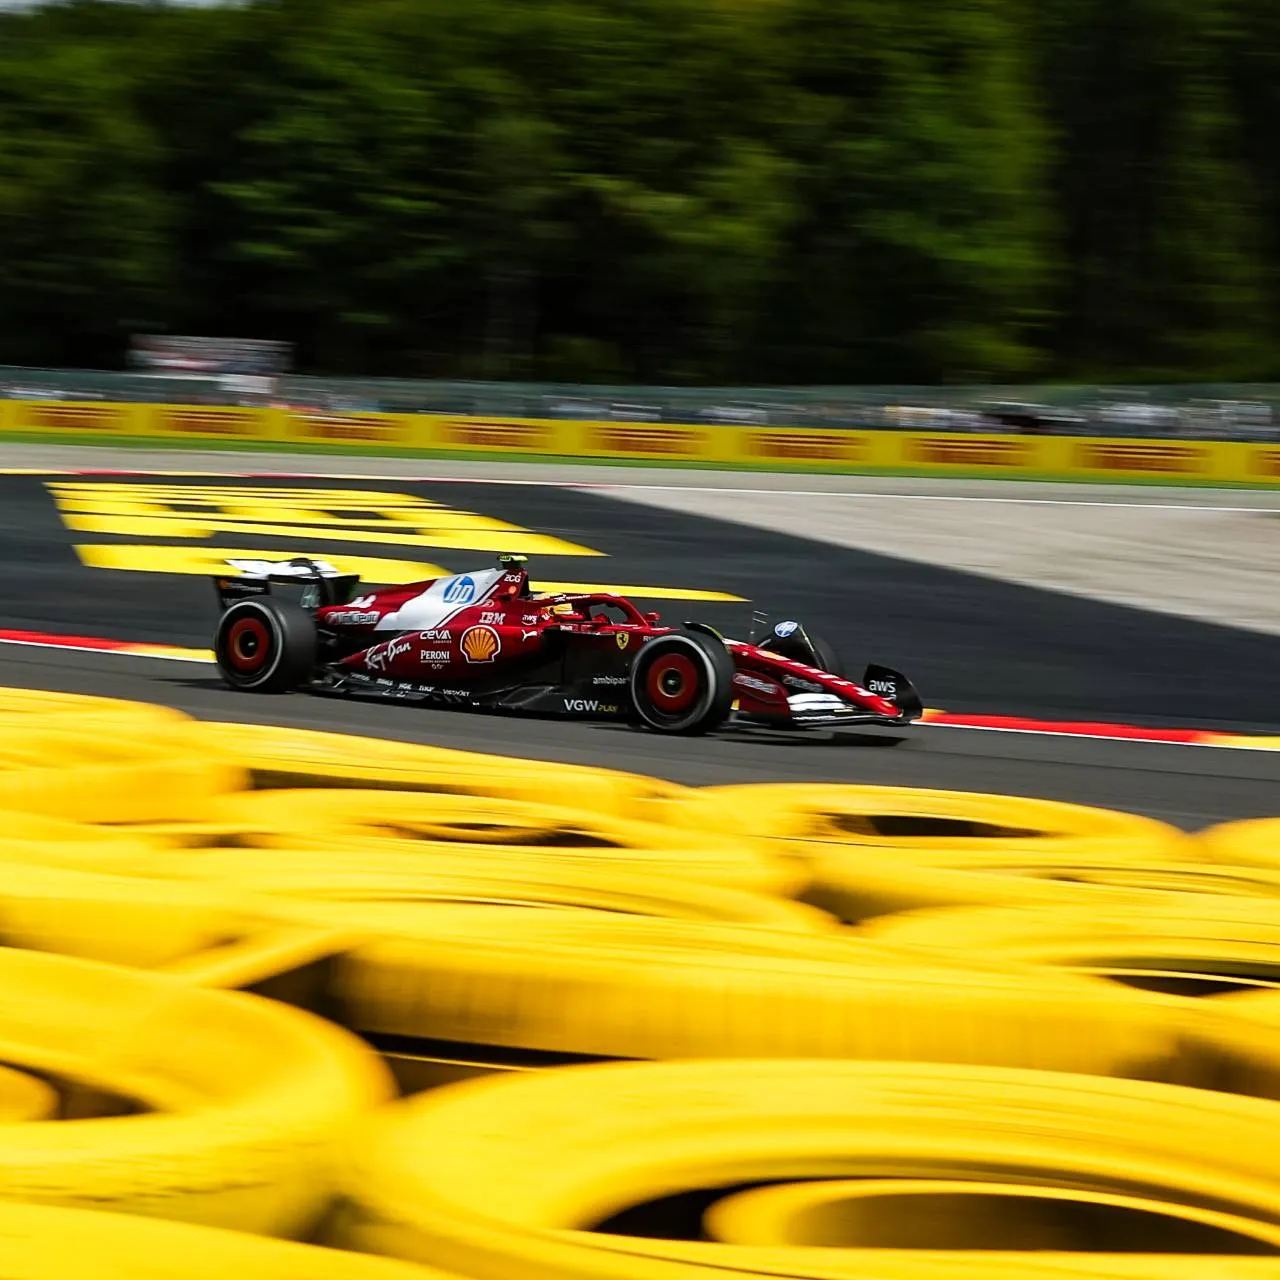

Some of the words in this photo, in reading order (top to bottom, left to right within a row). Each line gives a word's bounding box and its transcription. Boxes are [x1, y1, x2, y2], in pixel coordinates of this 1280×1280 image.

[444, 577, 474, 604] hp
[479, 611, 506, 625] IBM
[365, 636, 411, 671] Ray-Ban
[420, 650, 450, 659] PERONI
[869, 679, 896, 693] aws
[564, 699, 598, 711] VGW
